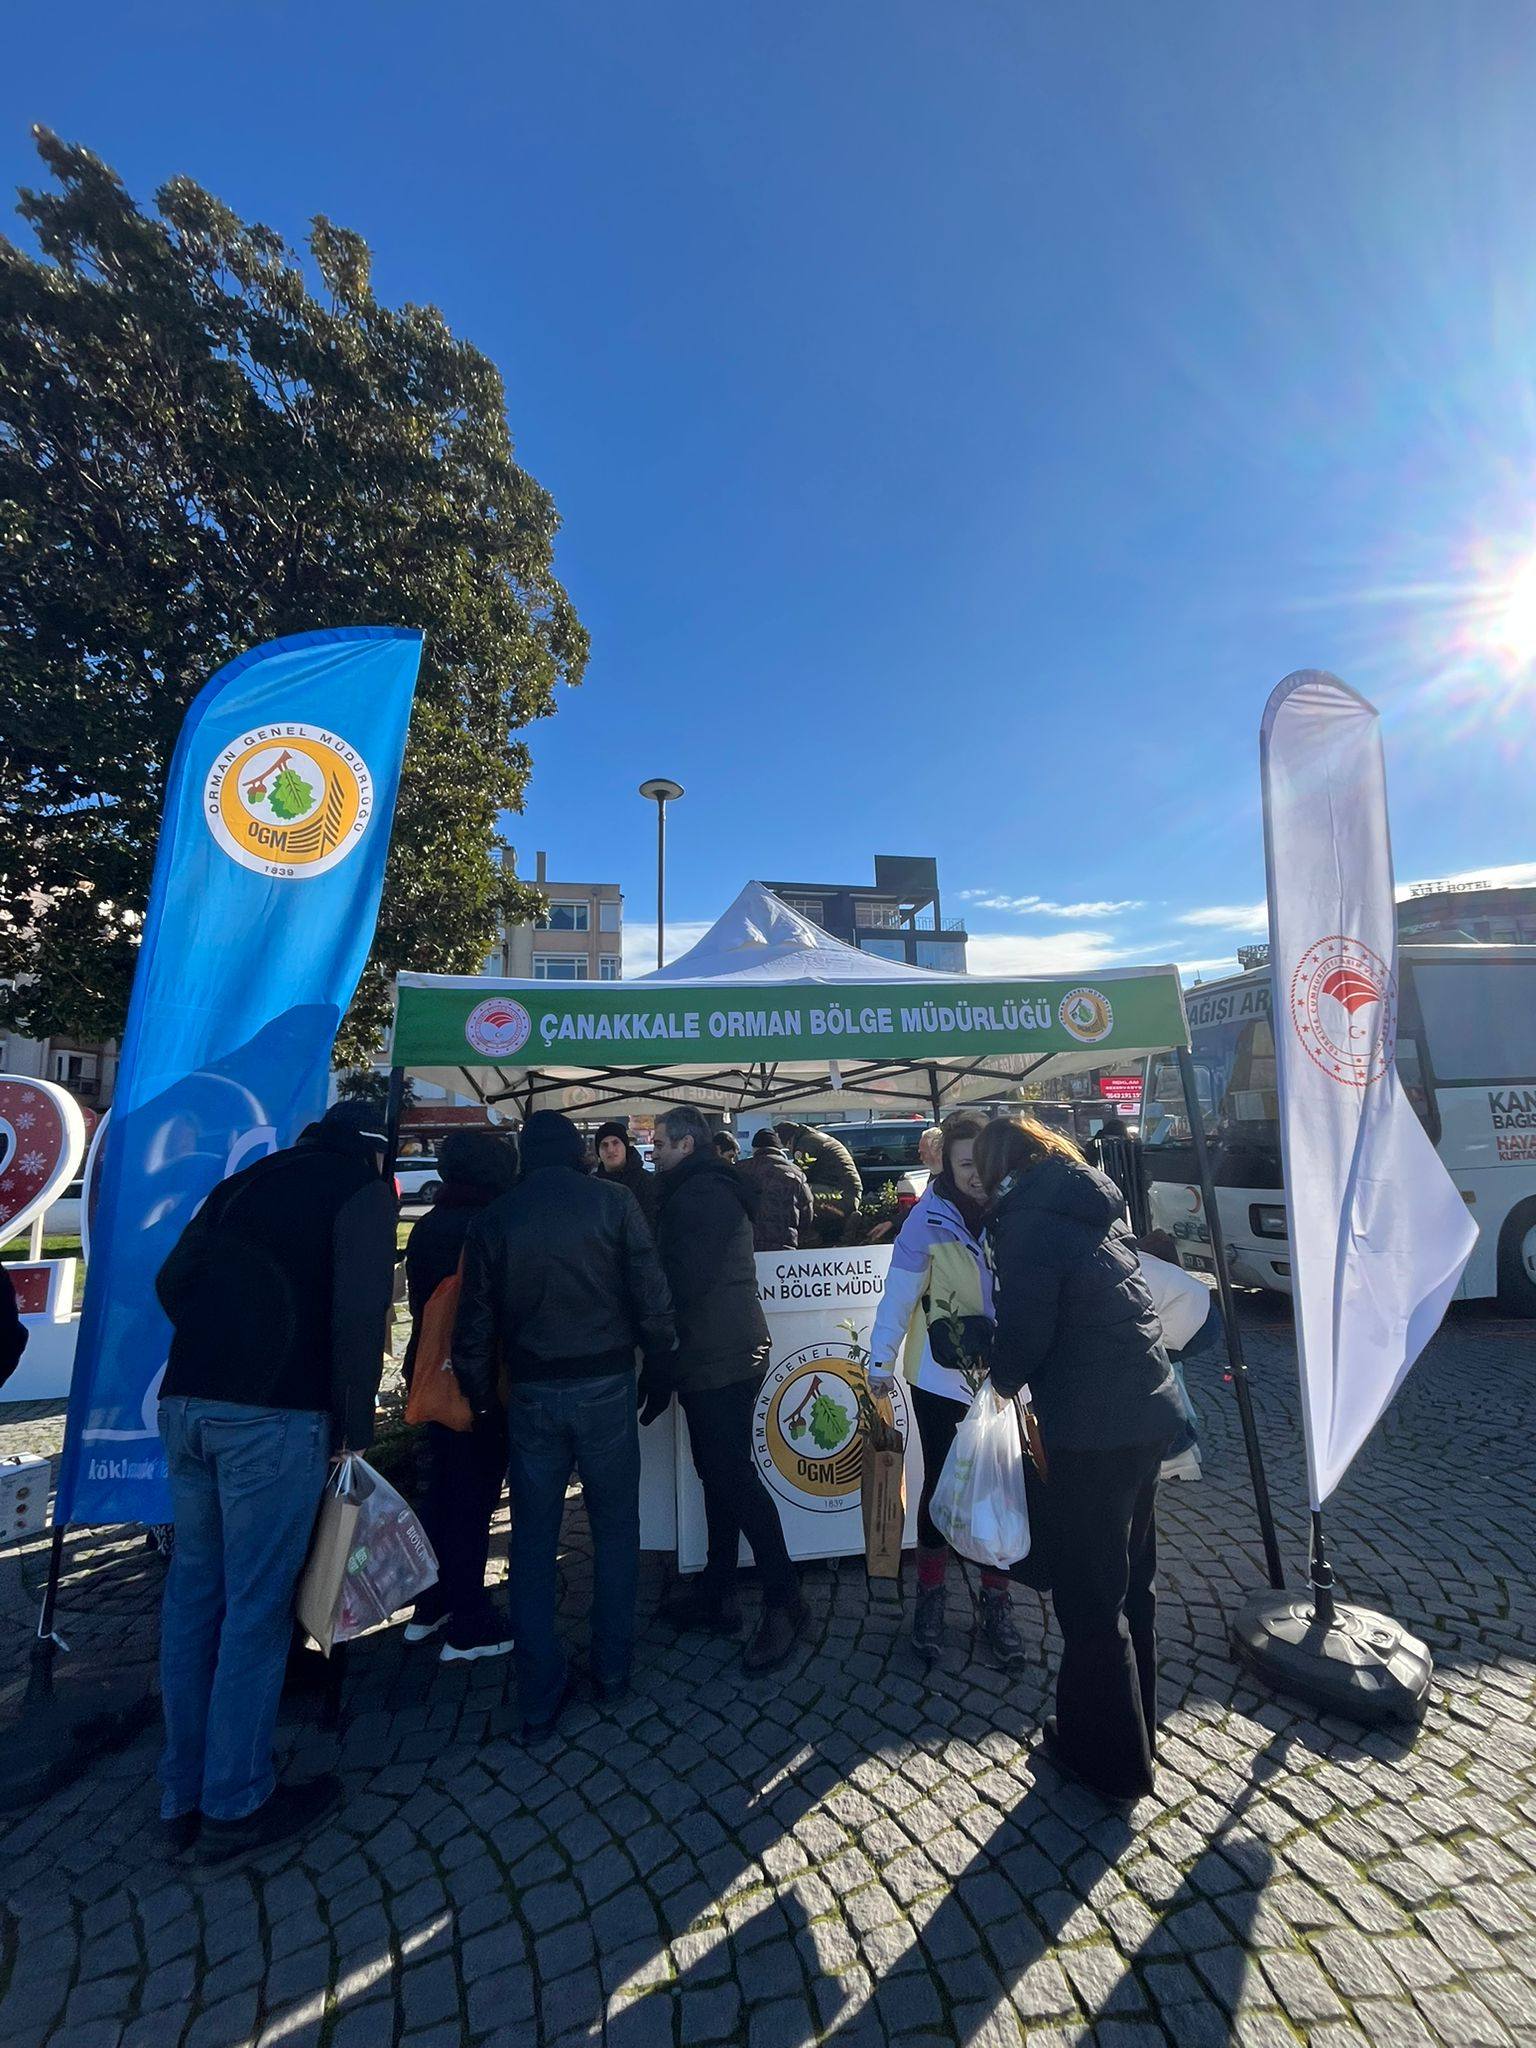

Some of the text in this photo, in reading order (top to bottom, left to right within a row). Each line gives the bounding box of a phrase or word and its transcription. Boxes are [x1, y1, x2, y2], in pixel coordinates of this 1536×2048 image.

[208, 726, 372, 833] ORMAN GENEL MÜDÜRLÜĞÜ
[247, 821, 289, 852] OGM
[264, 864, 295, 877] 1839
[539, 1011, 701, 1047] ÇANAKKALE
[708, 1007, 802, 1039] ORMAN
[810, 1002, 894, 1035] BÖLGE
[902, 998, 1053, 1033] MÜDÜRLÜĞÜ
[1189, 996, 1235, 1026] AĞIŞI
[1495, 1135, 1536, 1151] HAYA
[776, 1259, 872, 1284] ÇANAKKALE
[780, 1280, 832, 1299] BÖLGE
[755, 1396, 773, 1469] ORMAN
[774, 1347, 833, 1383] GENEL
[797, 1459, 836, 1485] OGM
[823, 1499, 844, 1509] 1839
